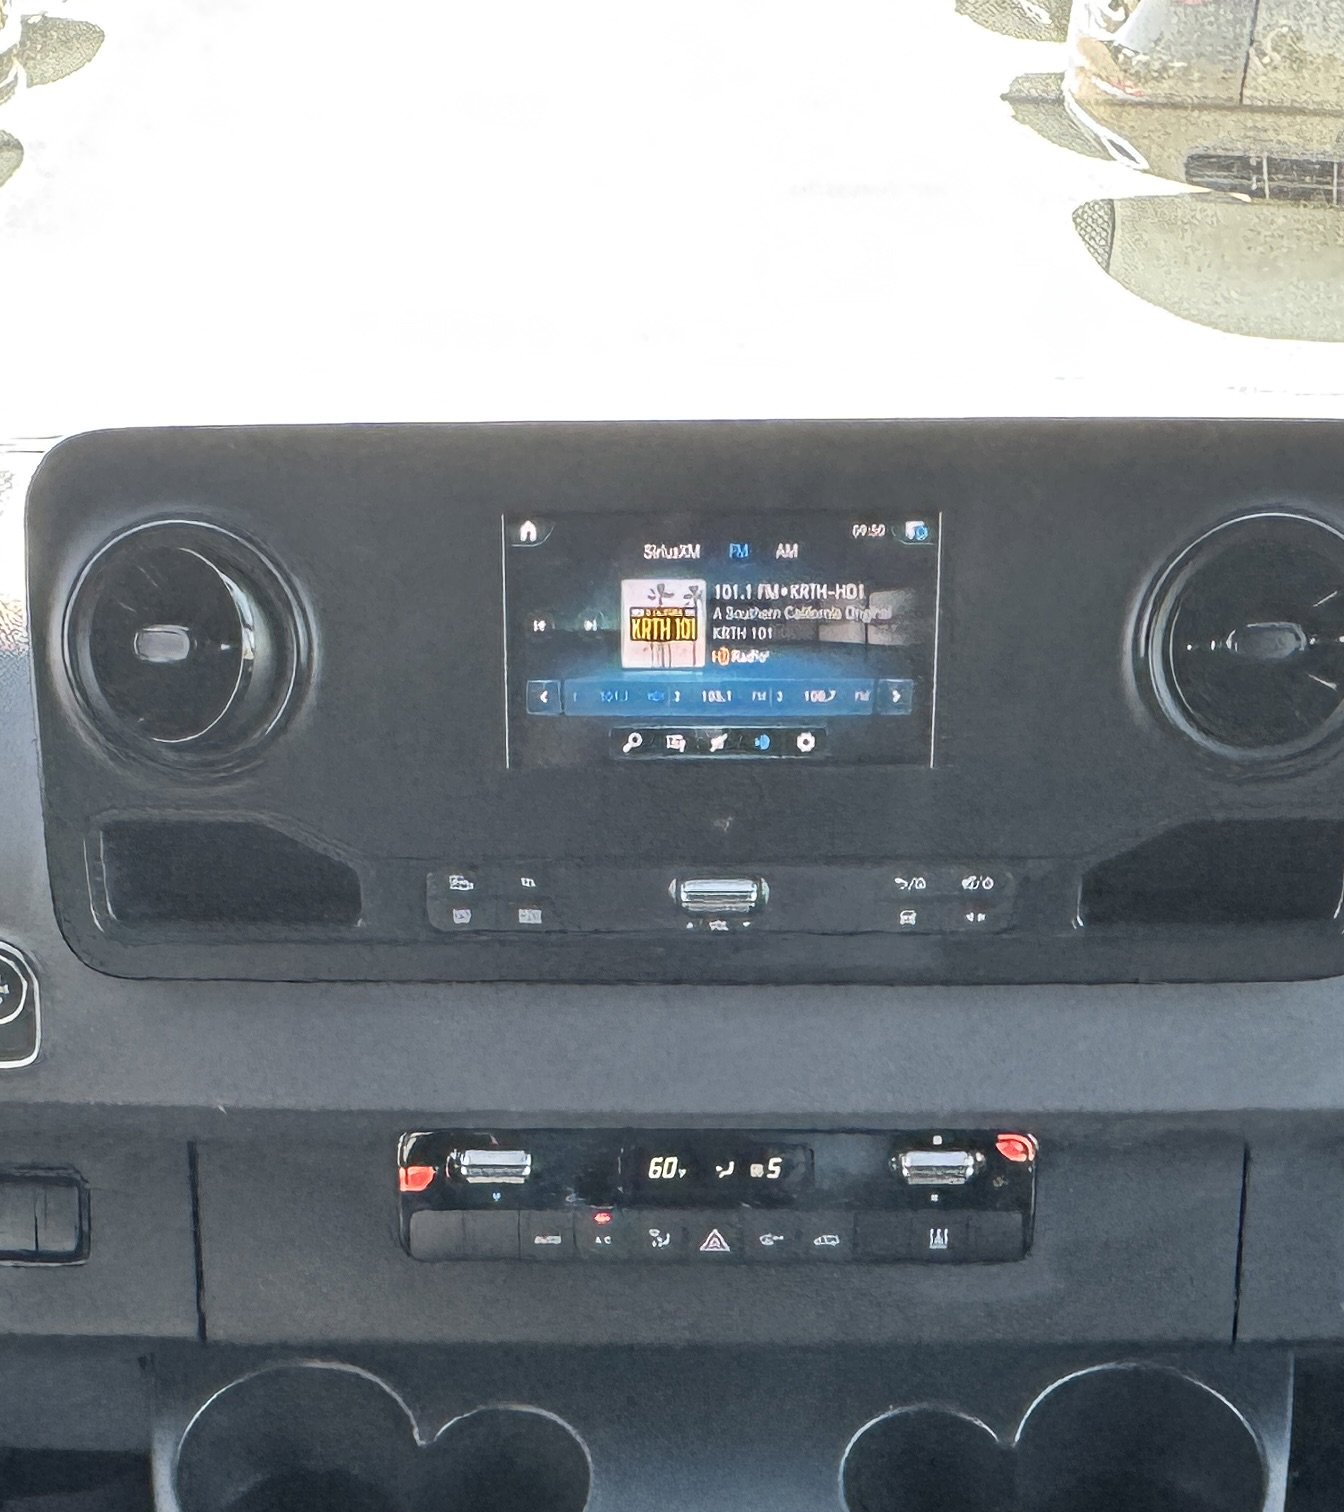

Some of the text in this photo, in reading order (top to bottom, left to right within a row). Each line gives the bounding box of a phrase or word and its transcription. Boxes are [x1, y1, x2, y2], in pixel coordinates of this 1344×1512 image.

[643, 543, 701, 560] SiriusXM
[775, 543, 799, 558] AM
[714, 583, 753, 600] 101.1
[712, 607, 723, 620] A
[631, 617, 696, 640] KRTH 101
[712, 625, 774, 641] KRTH 101
[648, 1156, 678, 1179] 60
[766, 1156, 783, 1179] 5
